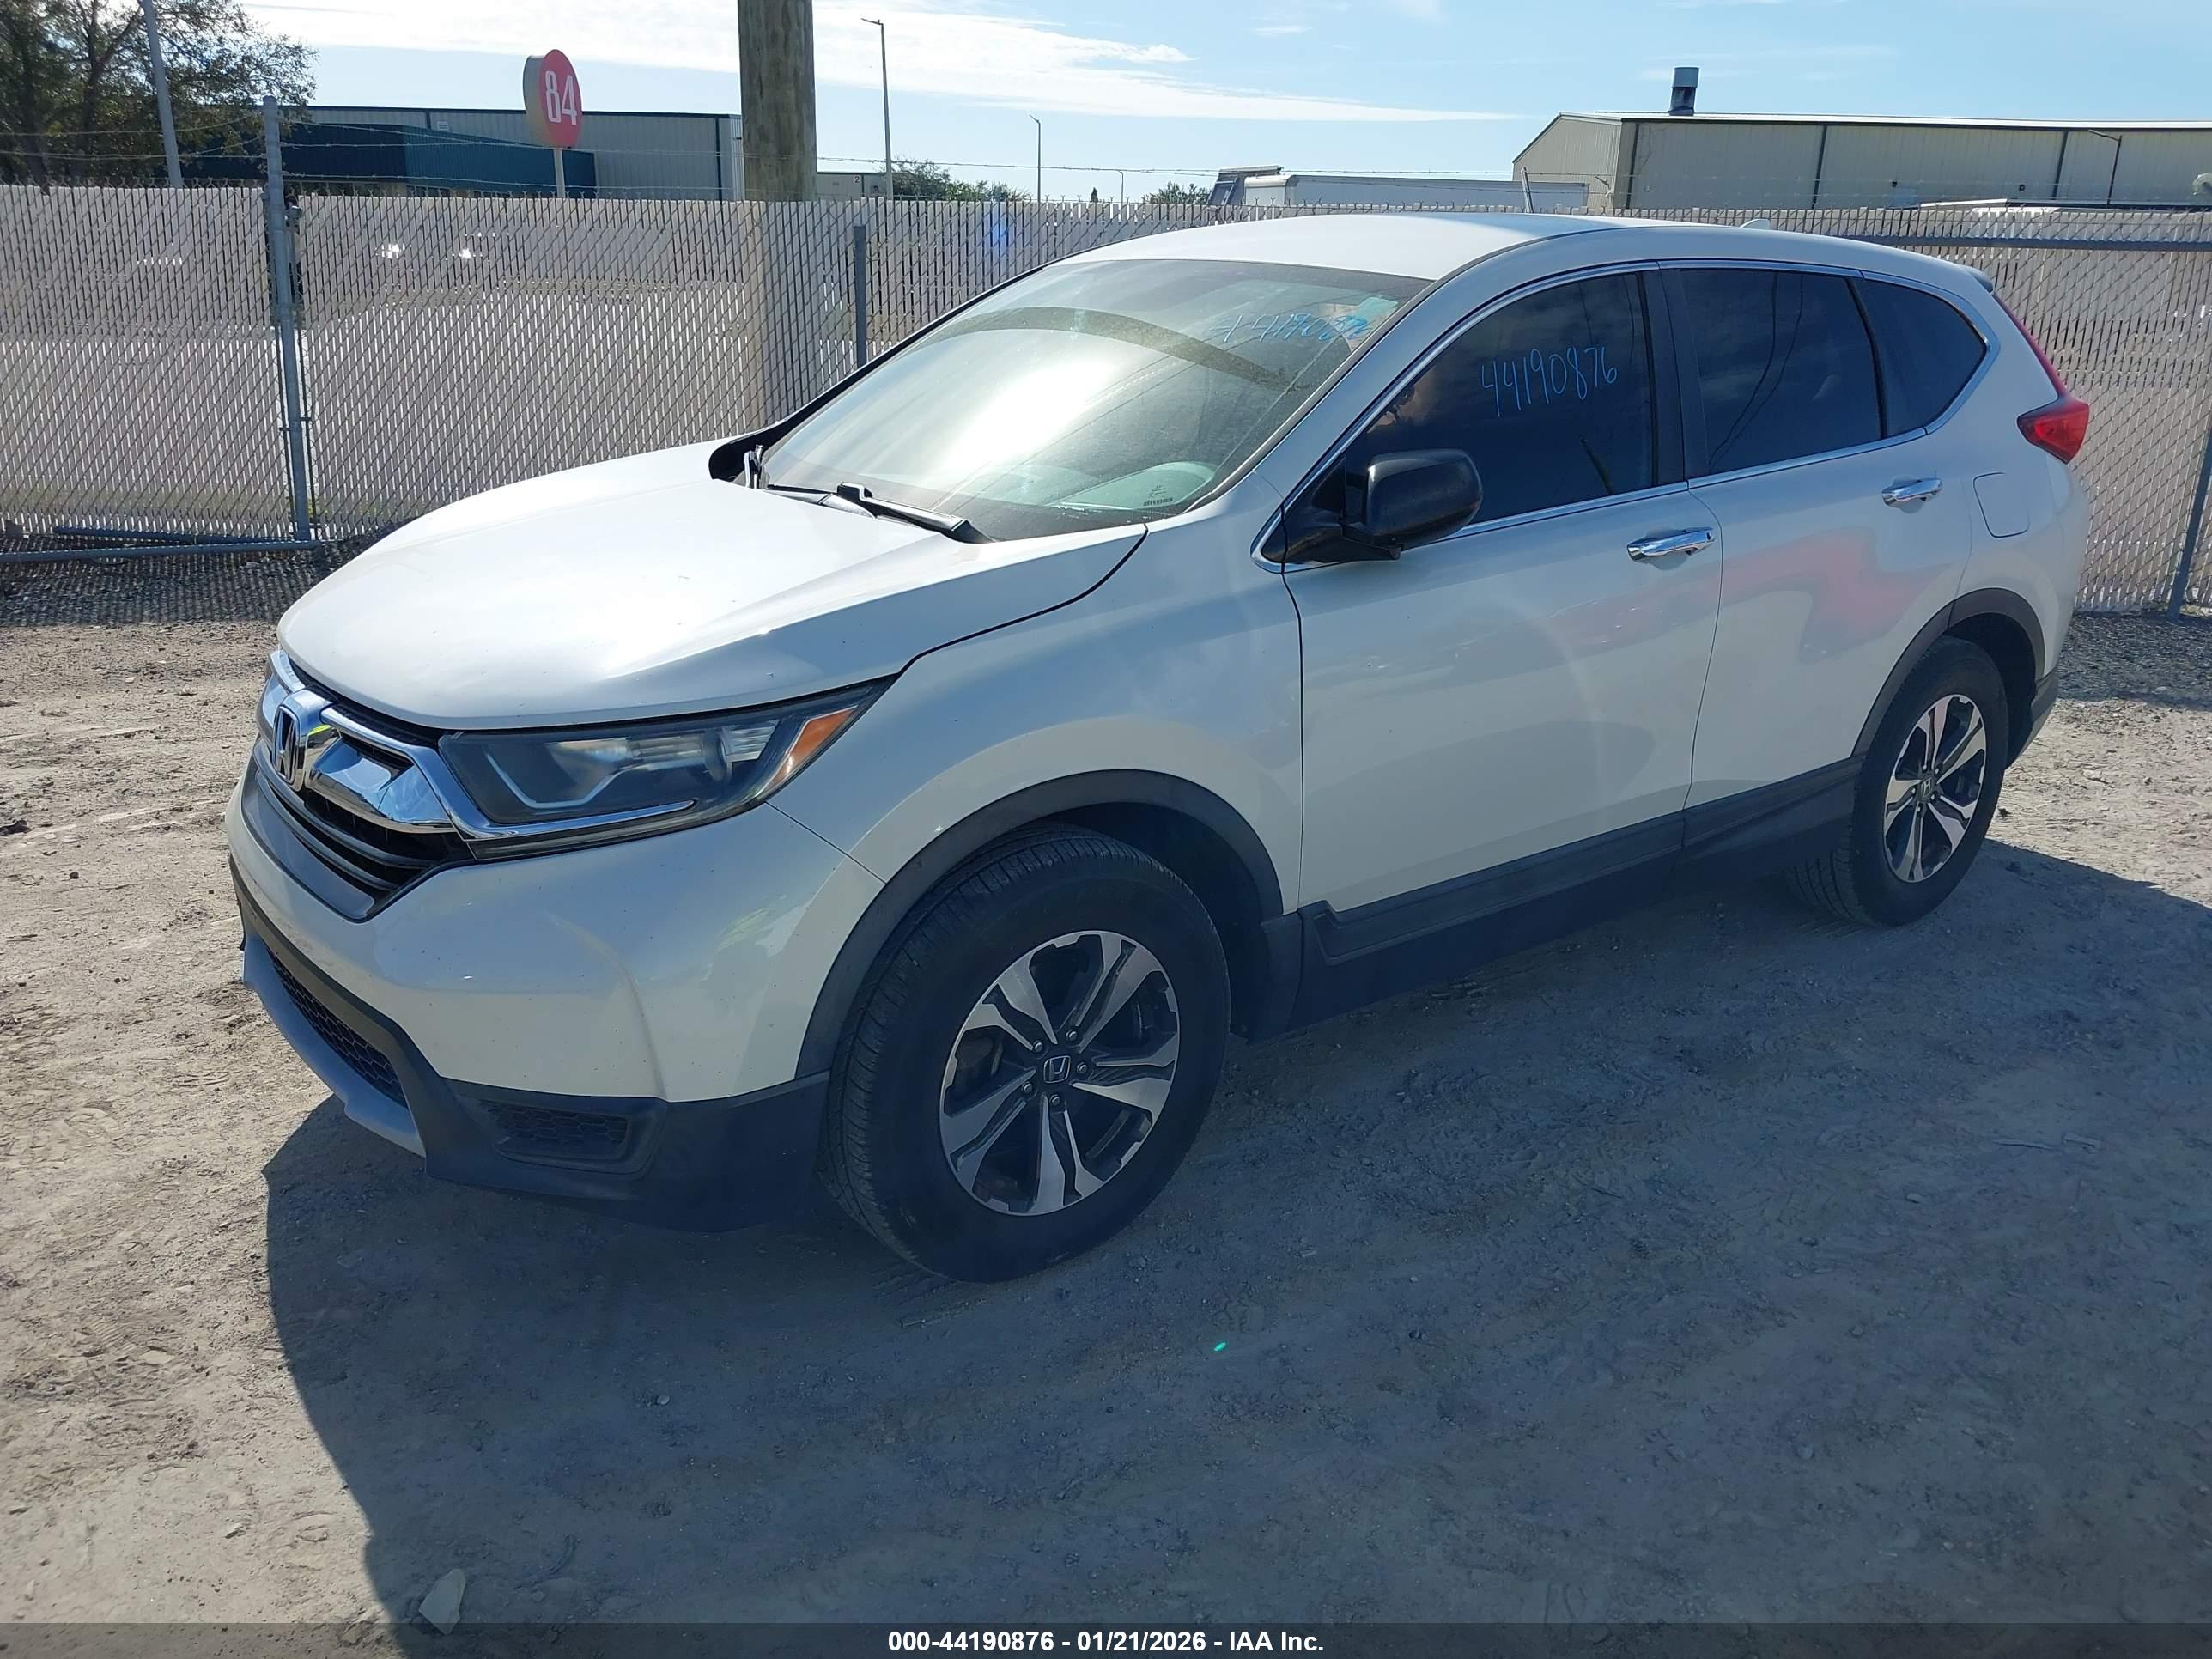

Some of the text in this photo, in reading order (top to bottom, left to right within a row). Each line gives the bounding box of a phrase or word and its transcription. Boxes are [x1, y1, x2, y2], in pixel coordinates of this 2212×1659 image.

[544, 70, 578, 125] 84
[854, 175, 860, 184] 2
[1481, 346, 1618, 419] 44190876
